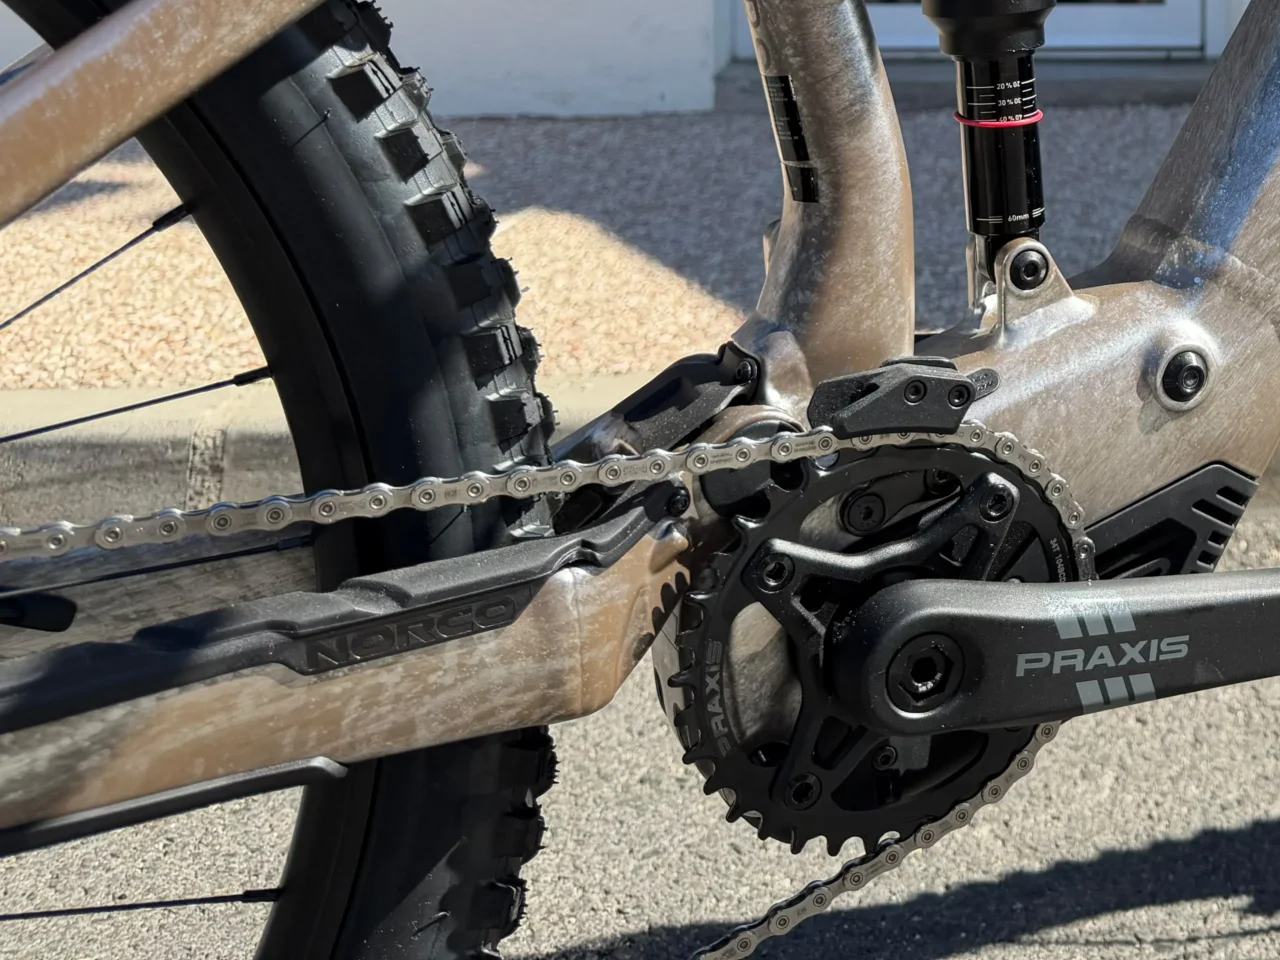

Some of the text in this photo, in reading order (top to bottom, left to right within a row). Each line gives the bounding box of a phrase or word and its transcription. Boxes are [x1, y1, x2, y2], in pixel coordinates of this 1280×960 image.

[1008, 214, 1030, 222] 60mm
[305, 596, 516, 672] NORCO
[1015, 635, 1190, 677] PRAXIS
[703, 639, 731, 757] PRAXIS
